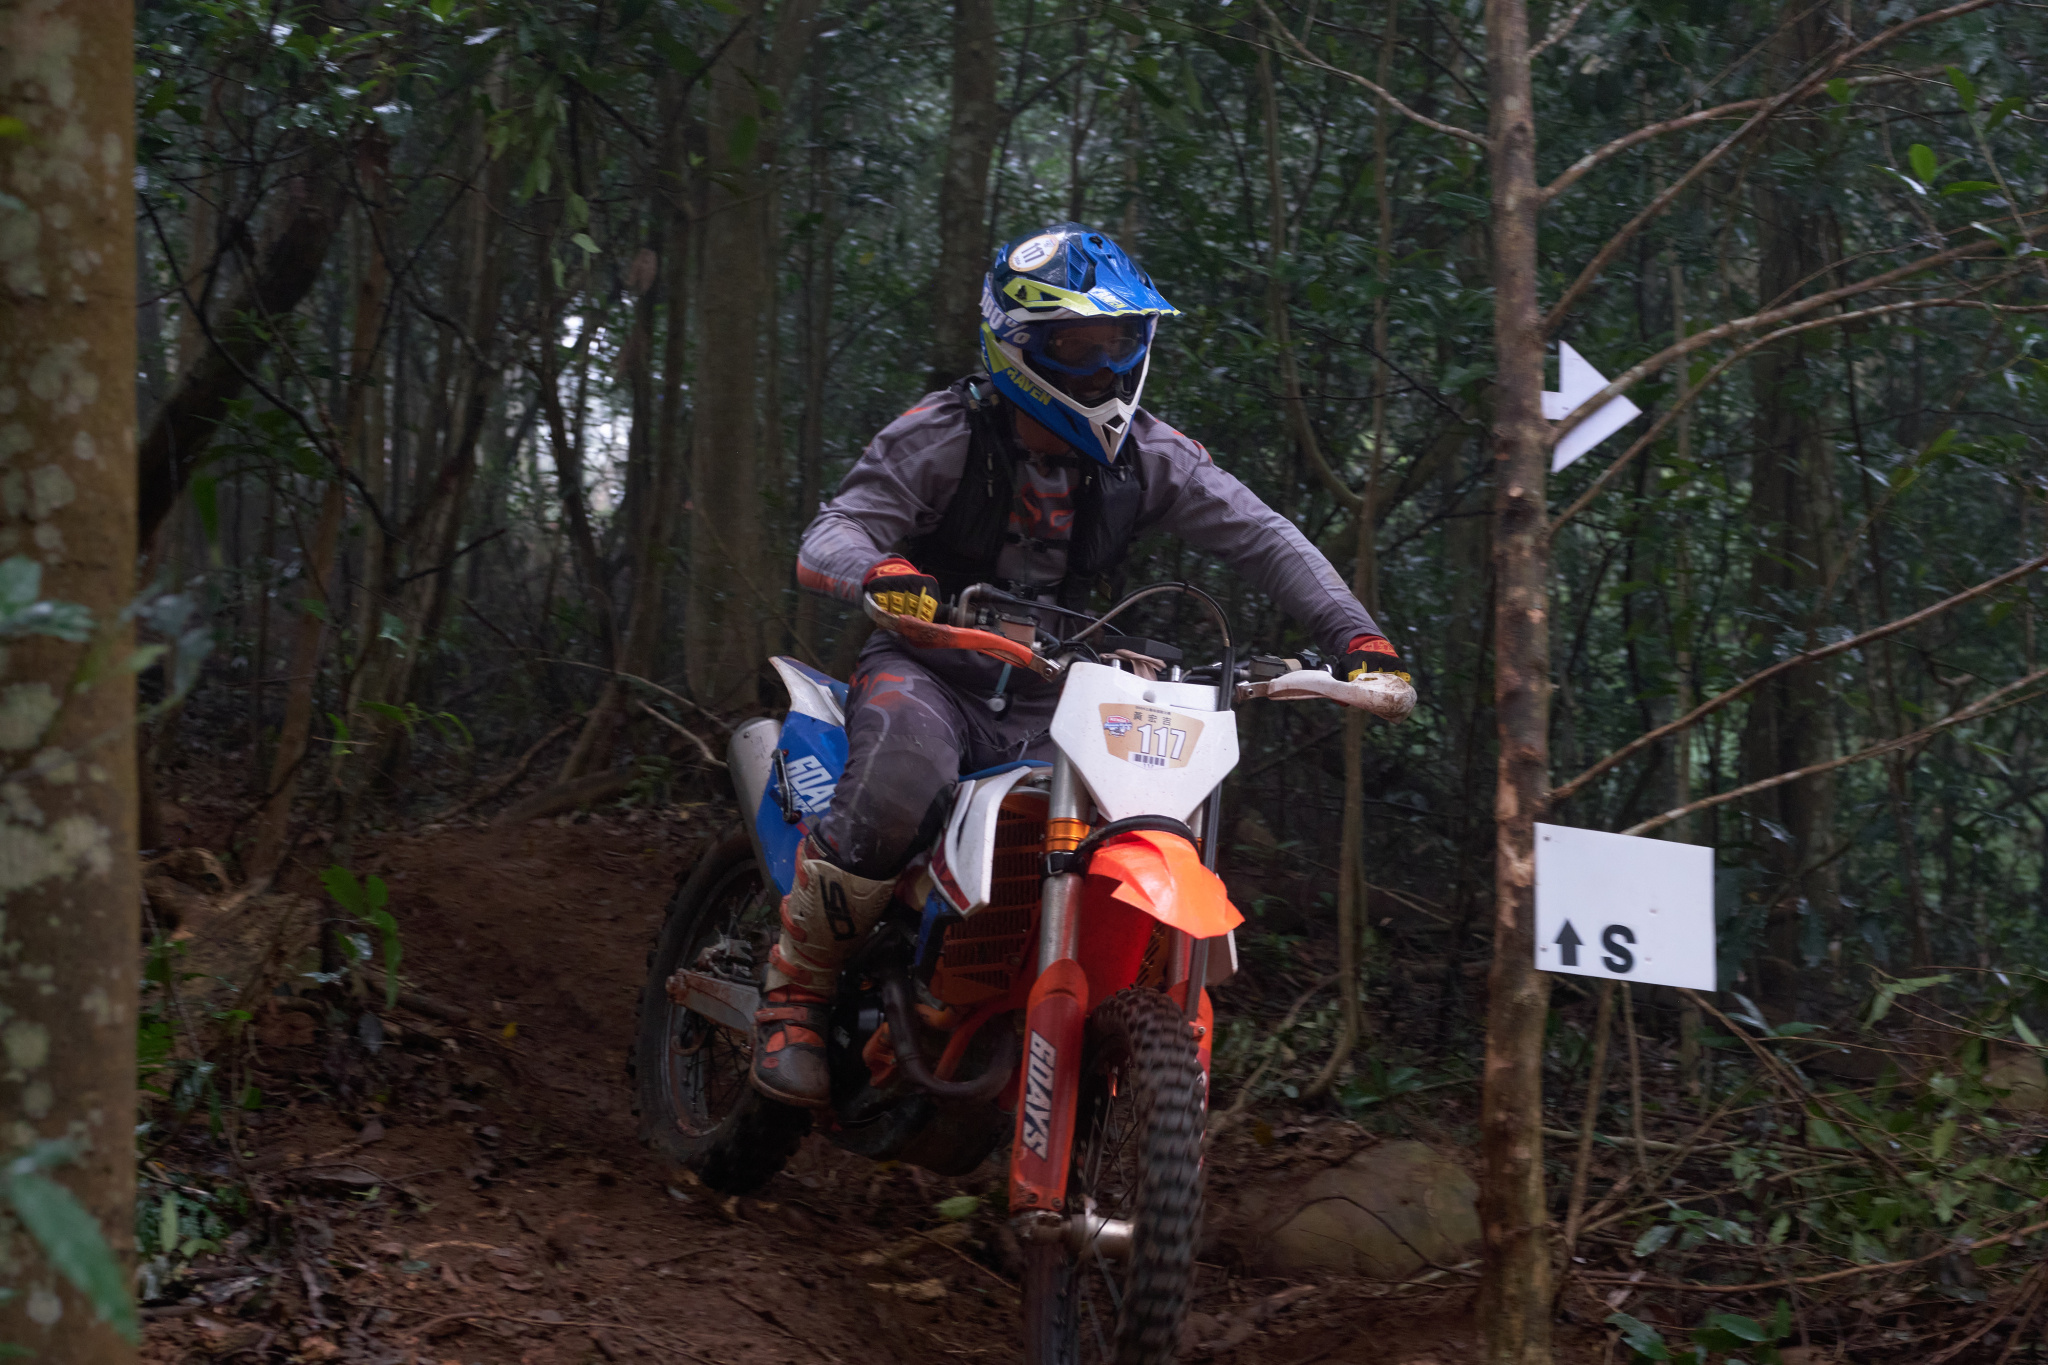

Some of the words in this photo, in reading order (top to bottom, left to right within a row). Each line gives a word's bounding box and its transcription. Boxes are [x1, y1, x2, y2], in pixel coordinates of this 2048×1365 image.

[979, 286, 1031, 344] 100%
[1006, 366, 1052, 406] RAVEN
[1137, 723, 1187, 760] 117
[1601, 924, 1637, 974] S
